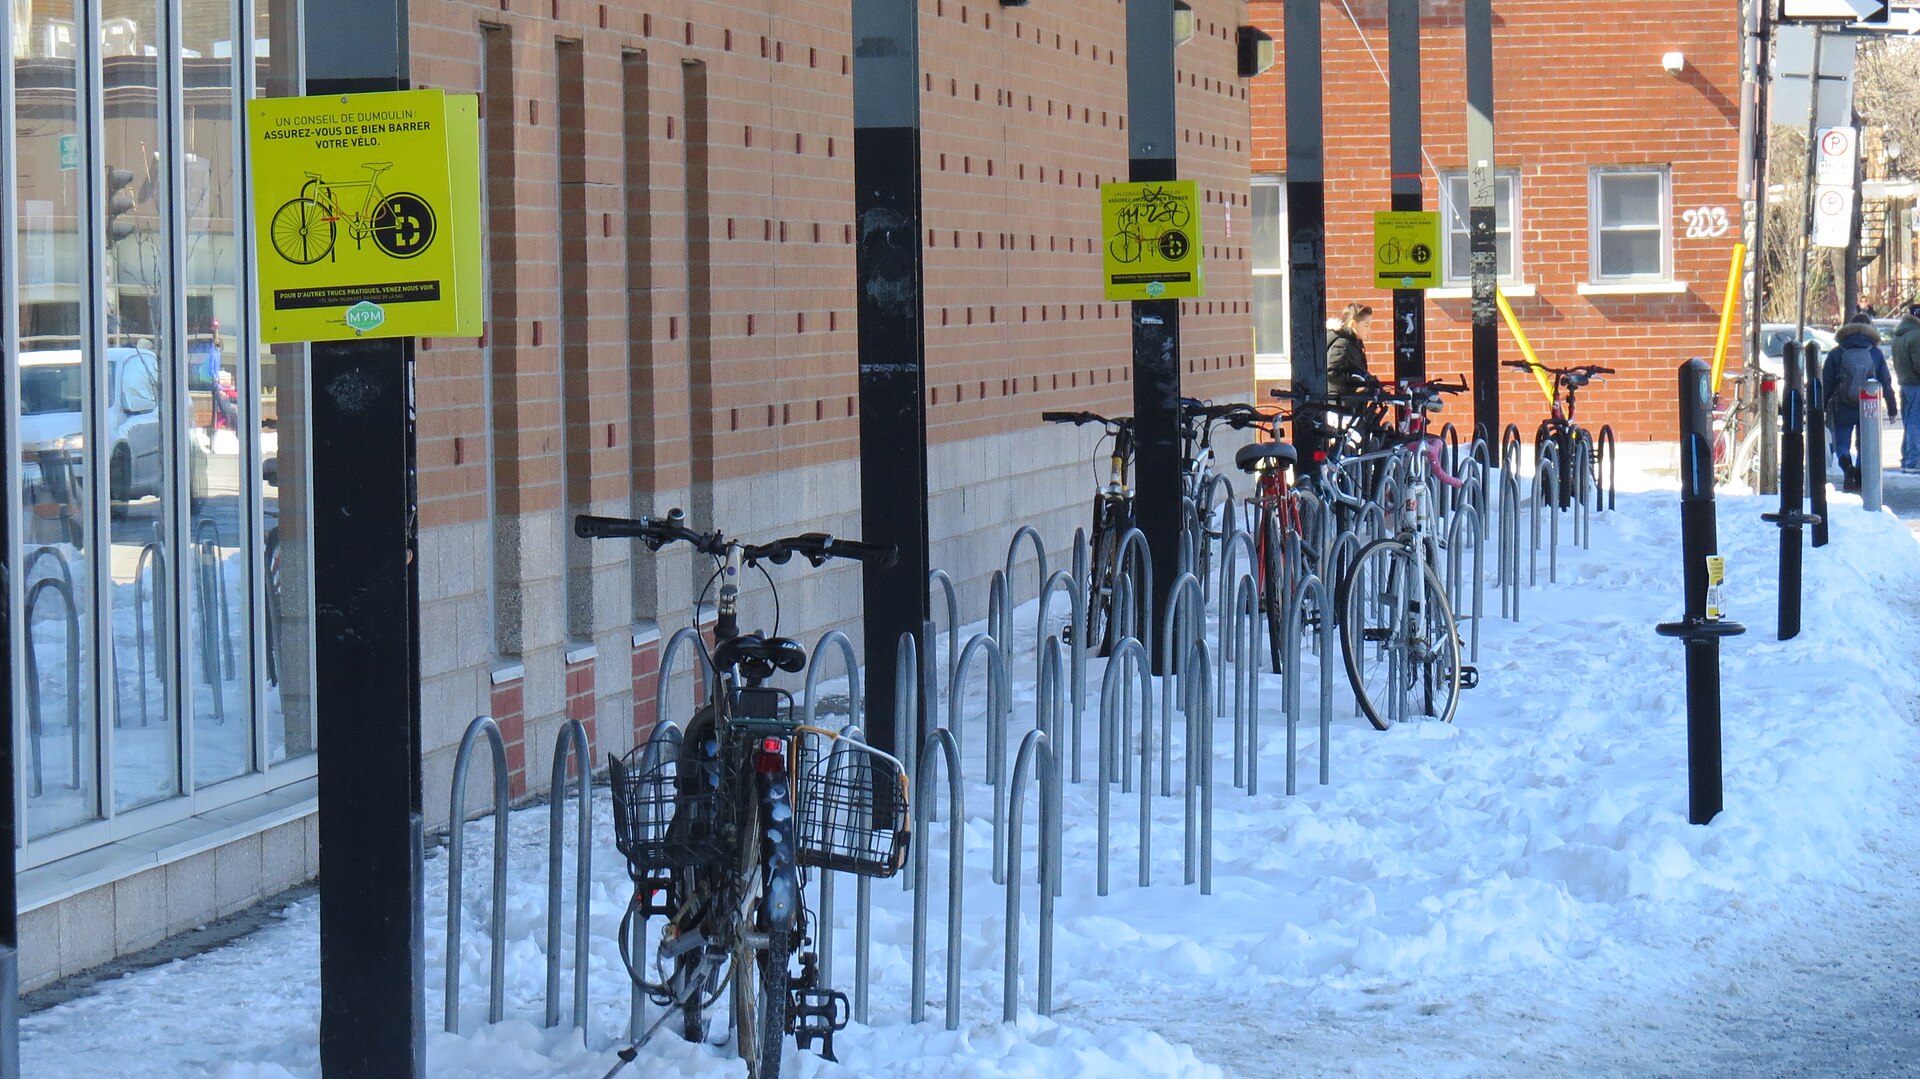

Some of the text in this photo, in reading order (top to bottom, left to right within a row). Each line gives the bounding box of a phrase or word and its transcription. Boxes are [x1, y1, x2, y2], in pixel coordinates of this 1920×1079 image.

[275, 117, 291, 127] UN
[293, 114, 338, 126] CONSEIL
[341, 113, 354, 123] DE
[264, 121, 431, 140] ASSUREZ-VOUS DE BIEN BARRER
[315, 135, 381, 149] VOTRE VÉLO.
[1682, 206, 1729, 238] 203
[297, 290, 326, 298] D'AUTRES
